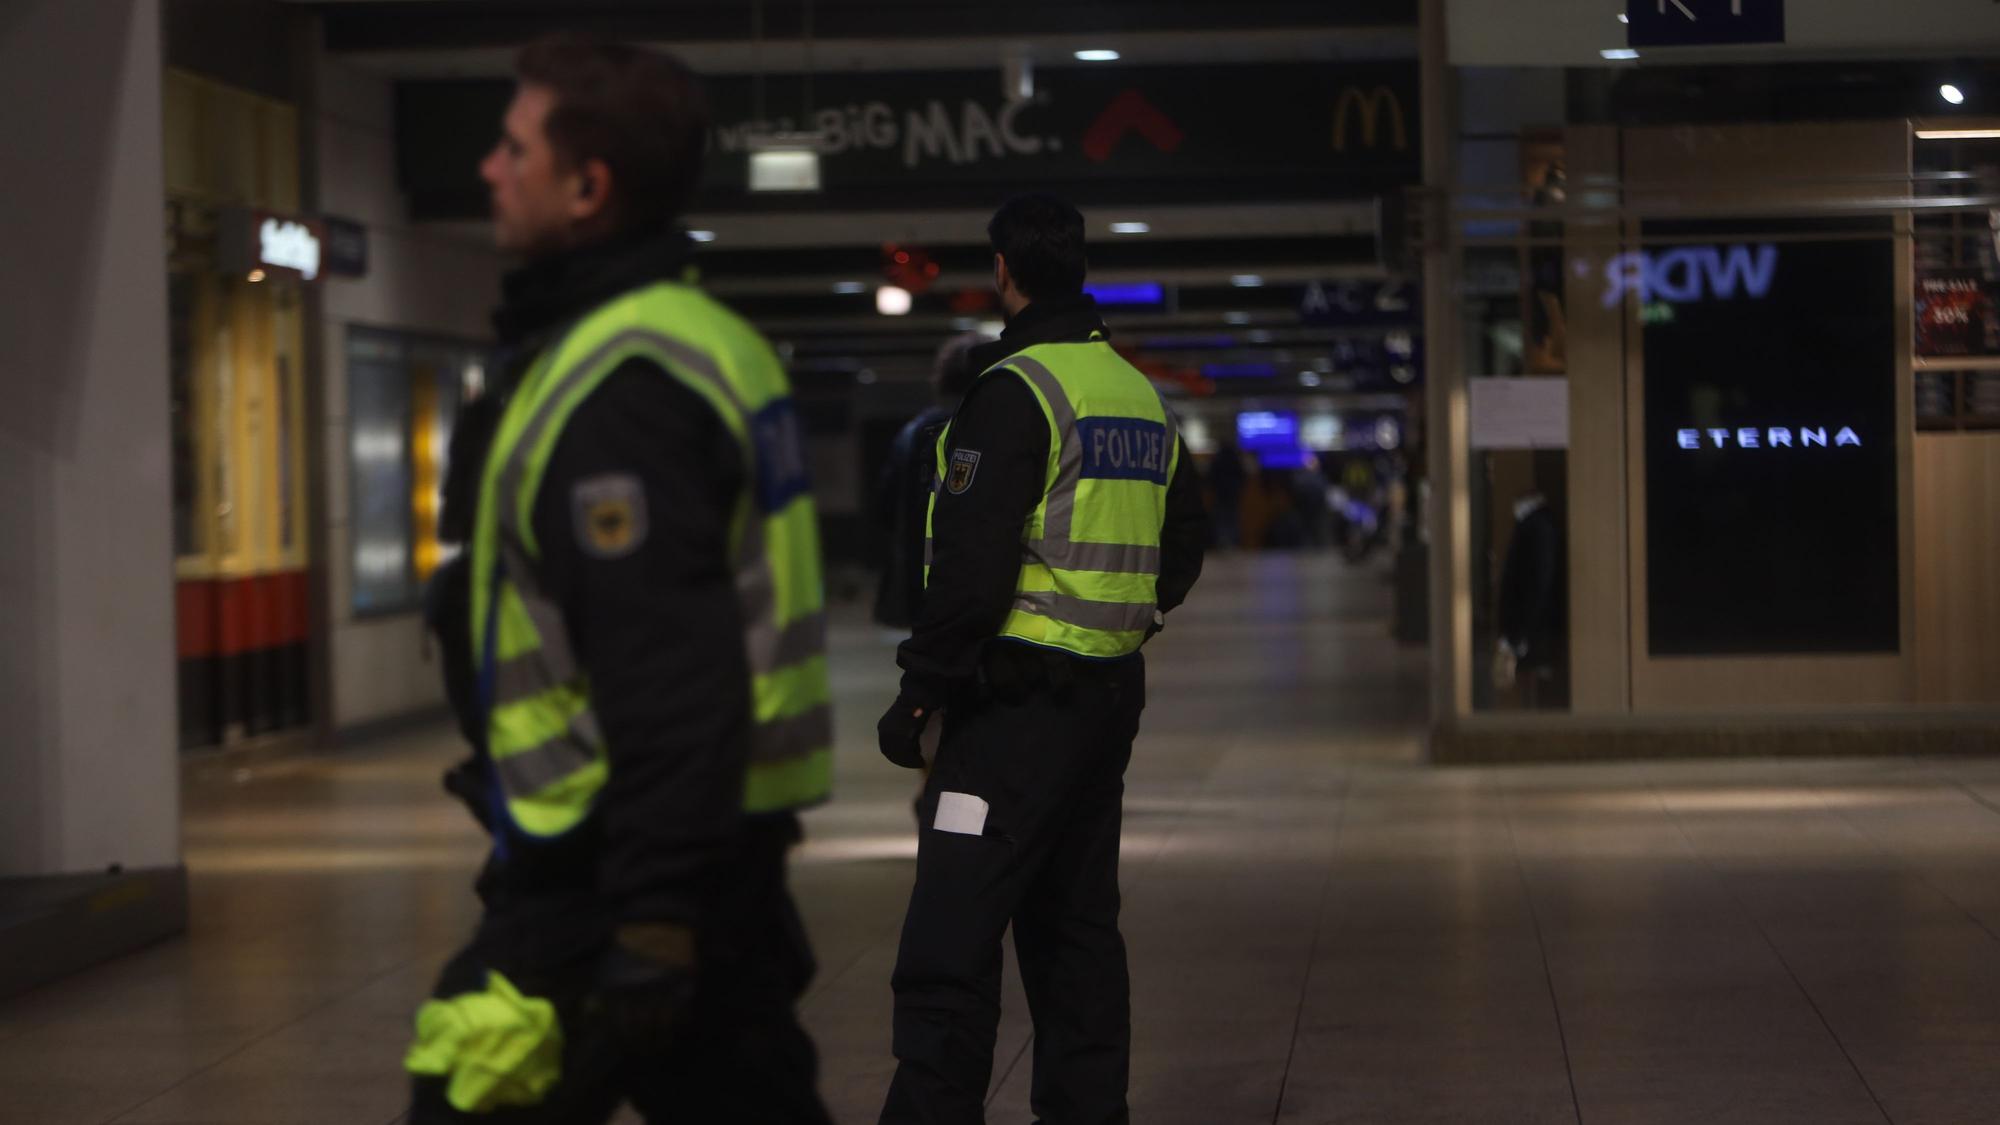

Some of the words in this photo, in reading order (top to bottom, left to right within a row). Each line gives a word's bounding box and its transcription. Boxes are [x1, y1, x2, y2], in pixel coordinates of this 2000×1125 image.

[1676, 425, 1862, 449] ETERNA
[954, 450, 979, 464] POLIZEI
[1094, 428, 1166, 473] POLIZEI
